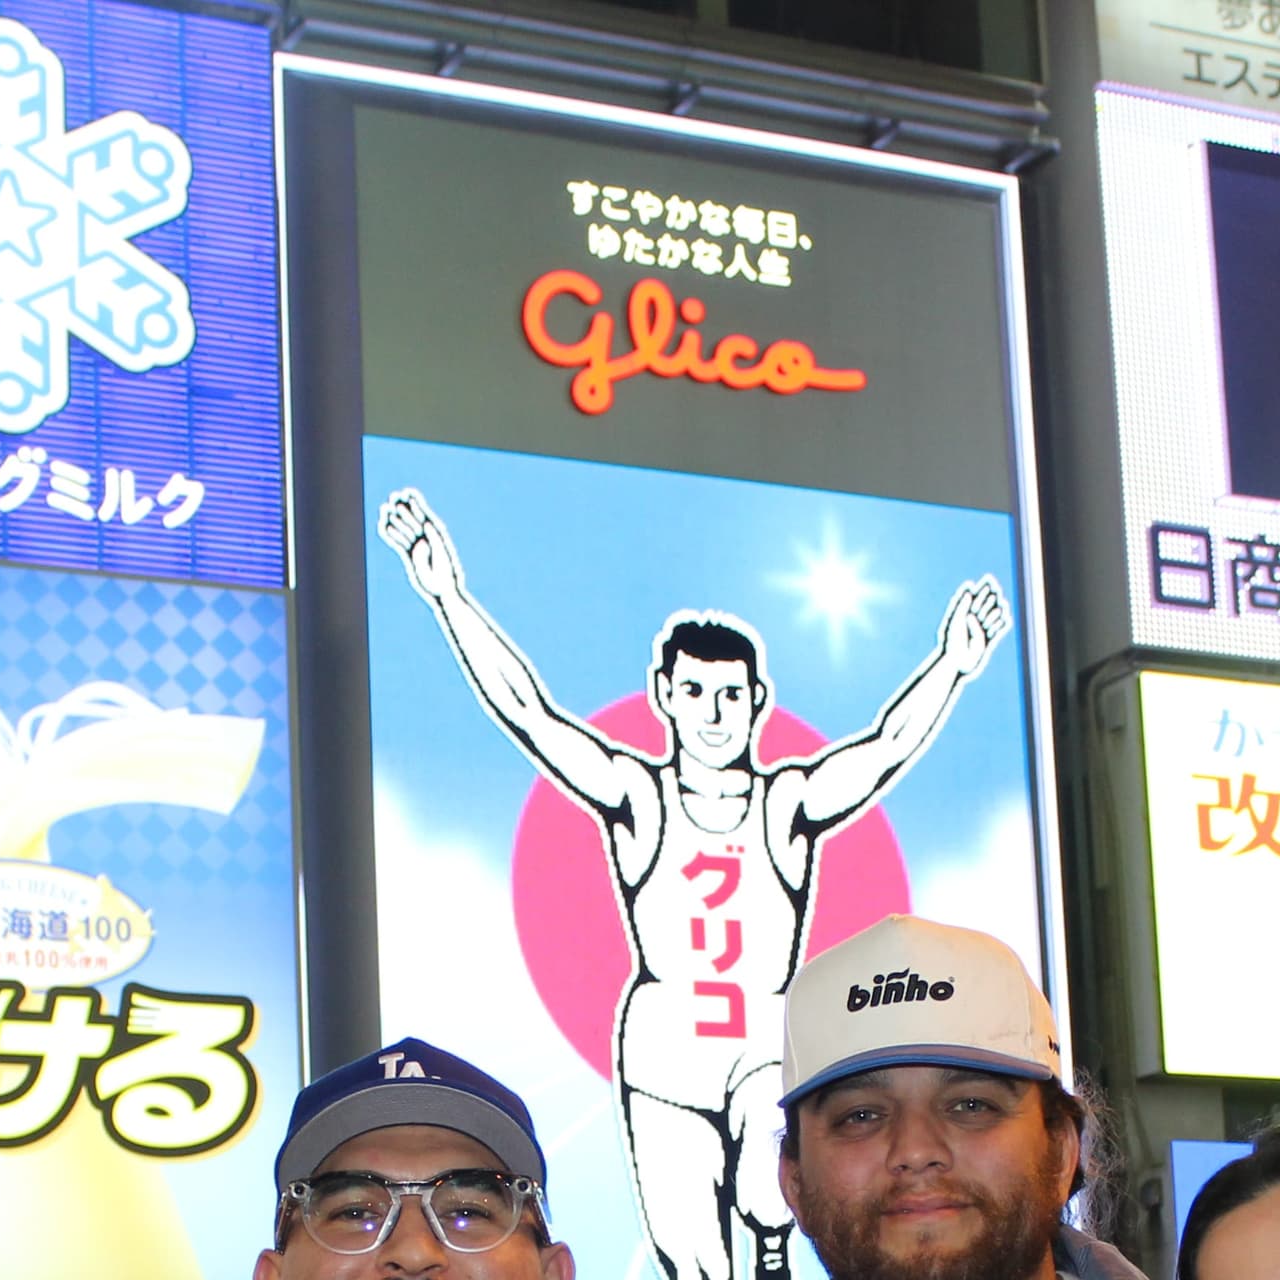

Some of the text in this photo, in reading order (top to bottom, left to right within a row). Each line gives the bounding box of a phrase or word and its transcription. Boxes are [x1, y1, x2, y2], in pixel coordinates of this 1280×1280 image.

[566, 179, 812, 251] すこやかな毎日、
[520, 268, 868, 416] Glico
[680, 844, 750, 1041] グリコ
